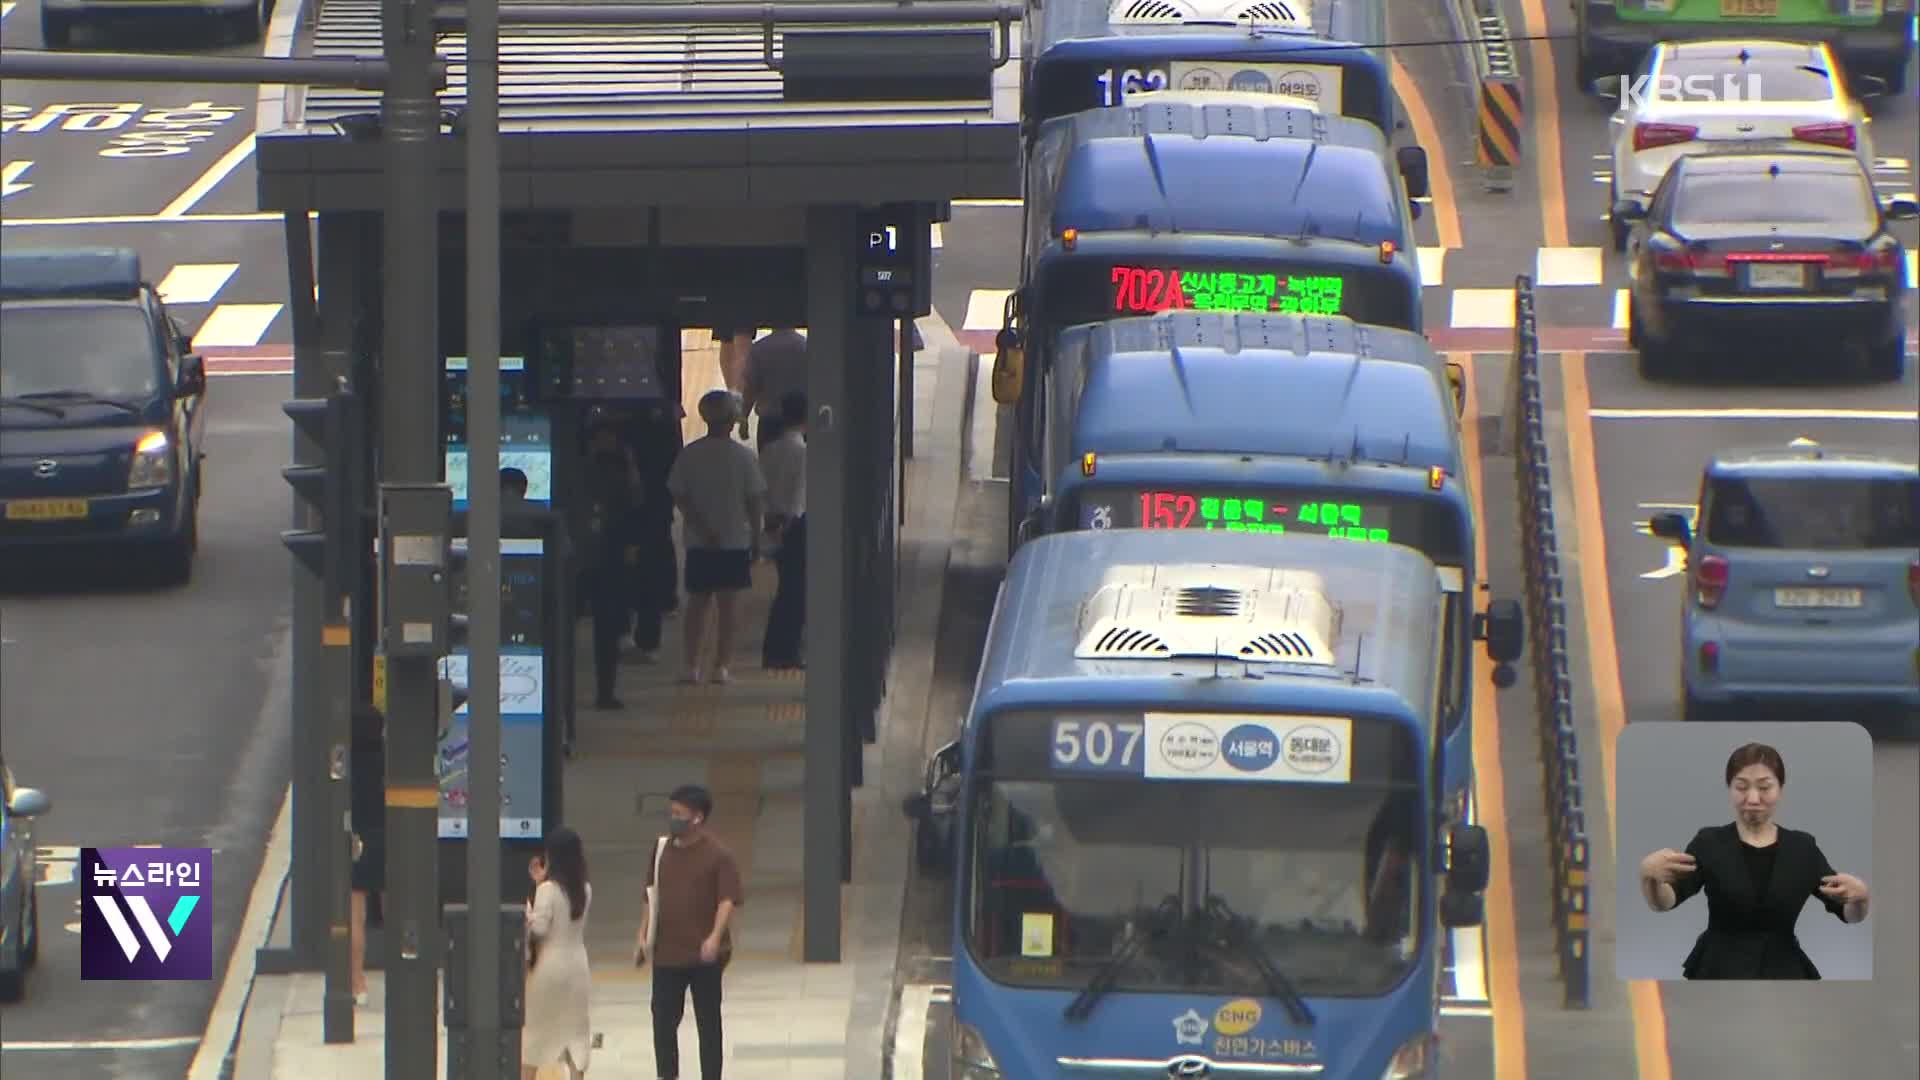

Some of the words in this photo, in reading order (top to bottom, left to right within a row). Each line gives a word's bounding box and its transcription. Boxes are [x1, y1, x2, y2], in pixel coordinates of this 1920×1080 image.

[1112, 266, 1185, 312] 702A
[1141, 491, 1197, 530] 152
[1054, 720, 1144, 766] 507
[1228, 739, 1274, 758] 서울역
[1289, 736, 1331, 753] 동대문
[1218, 1007, 1257, 1024] CNG
[1214, 1036, 1317, 1057] 천연가스버스
